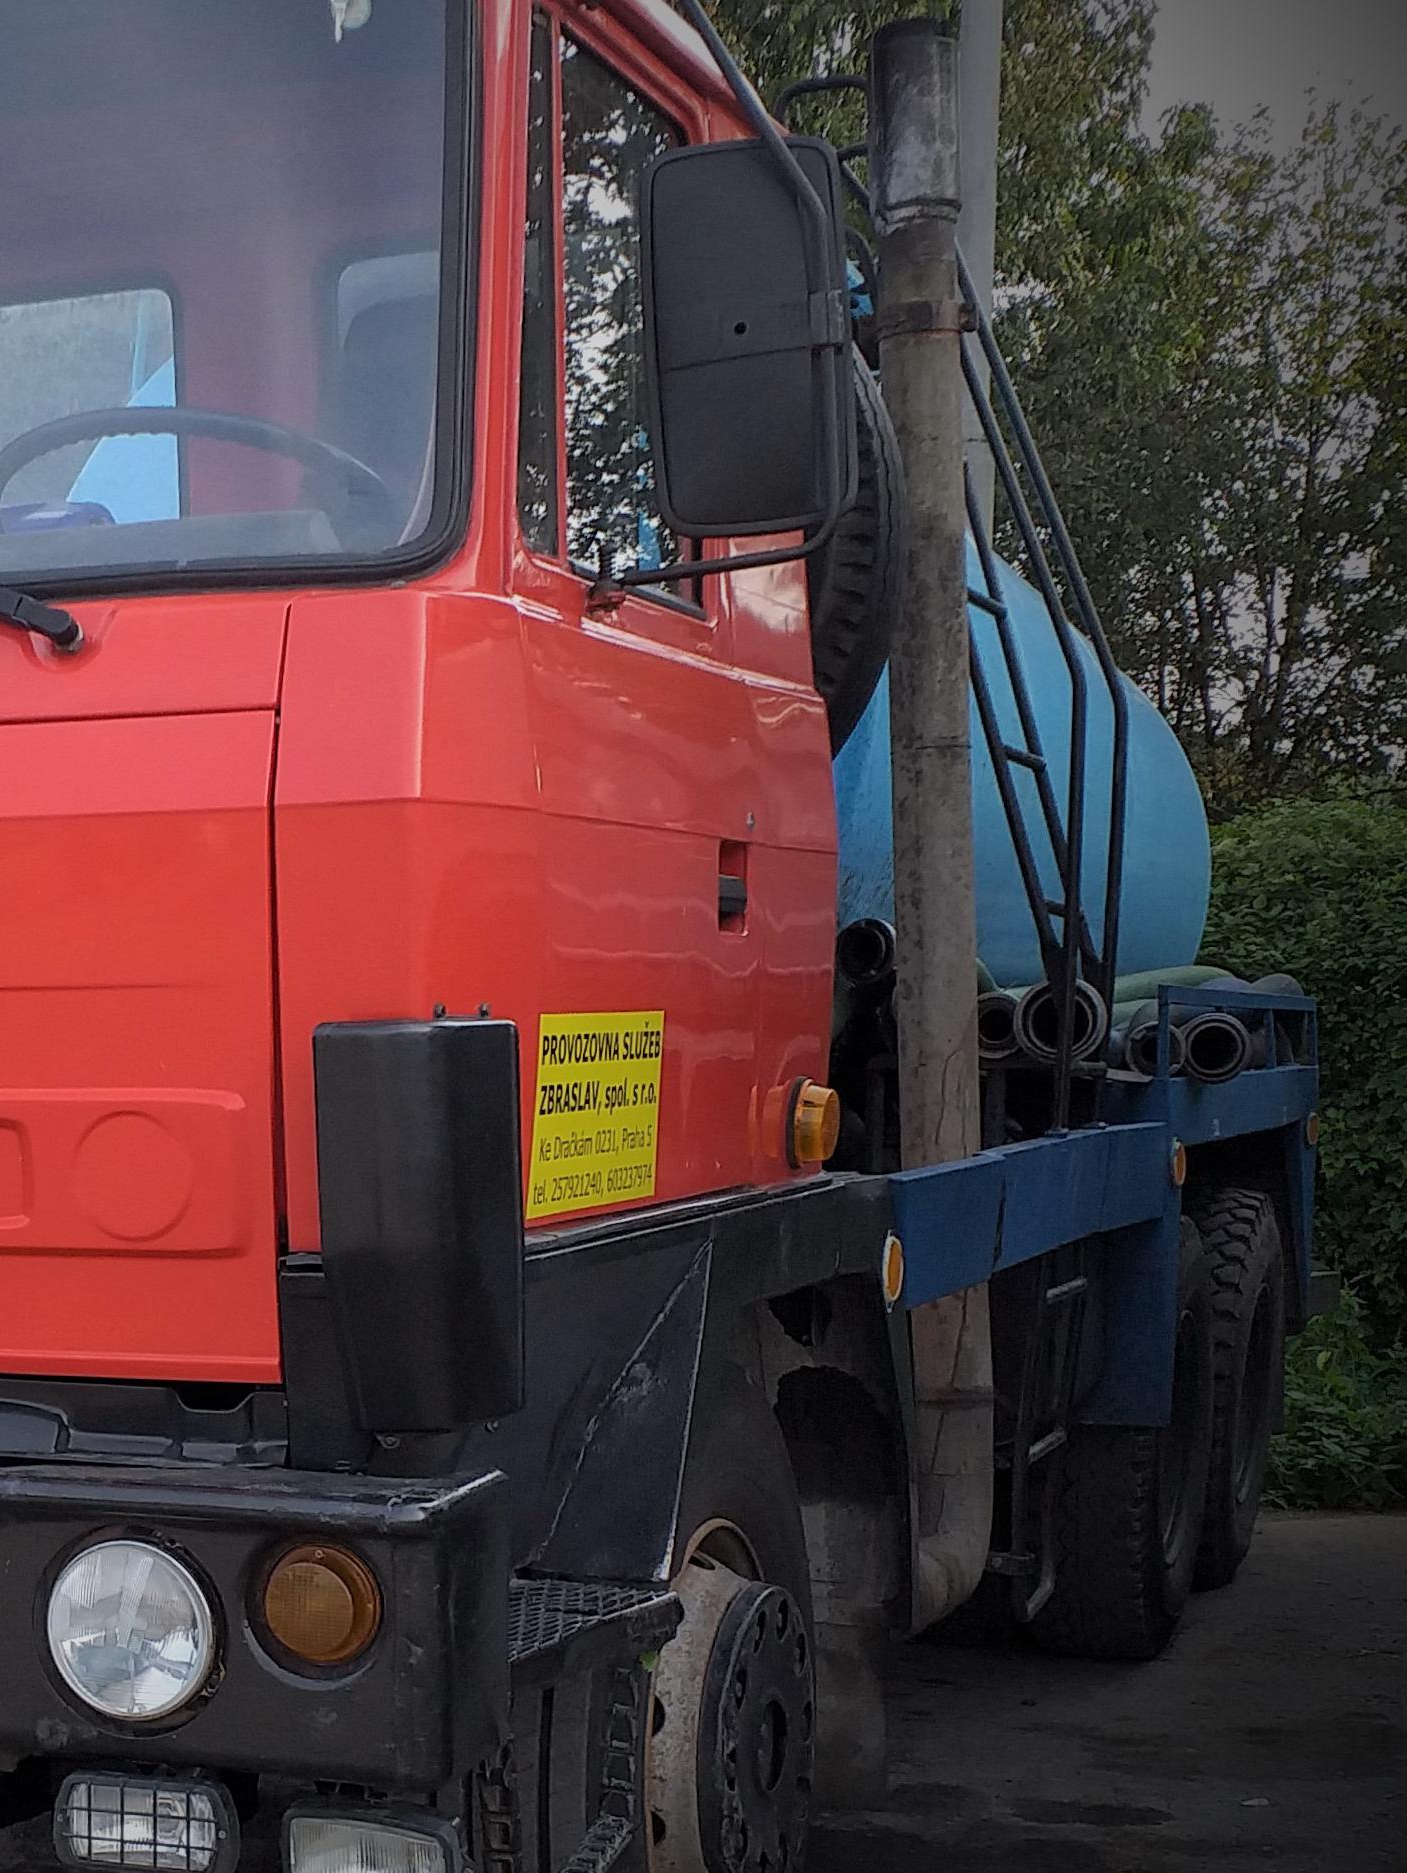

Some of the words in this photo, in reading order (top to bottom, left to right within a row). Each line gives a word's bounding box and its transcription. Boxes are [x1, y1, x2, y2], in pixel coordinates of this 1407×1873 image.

[542, 1032, 619, 1065] PROVOZOVNA
[623, 1022, 660, 1060] SLUŽEB
[539, 1081, 601, 1115] ZBRASLAV,
[605, 1077, 629, 1115] spol.
[632, 1085, 638, 1106] s
[641, 1083, 657, 1105] r.o.
[539, 1139, 551, 1162] Ke
[595, 1129, 618, 1157] 0231,
[622, 1126, 645, 1152] Praha
[533, 1180, 548, 1205] tel.
